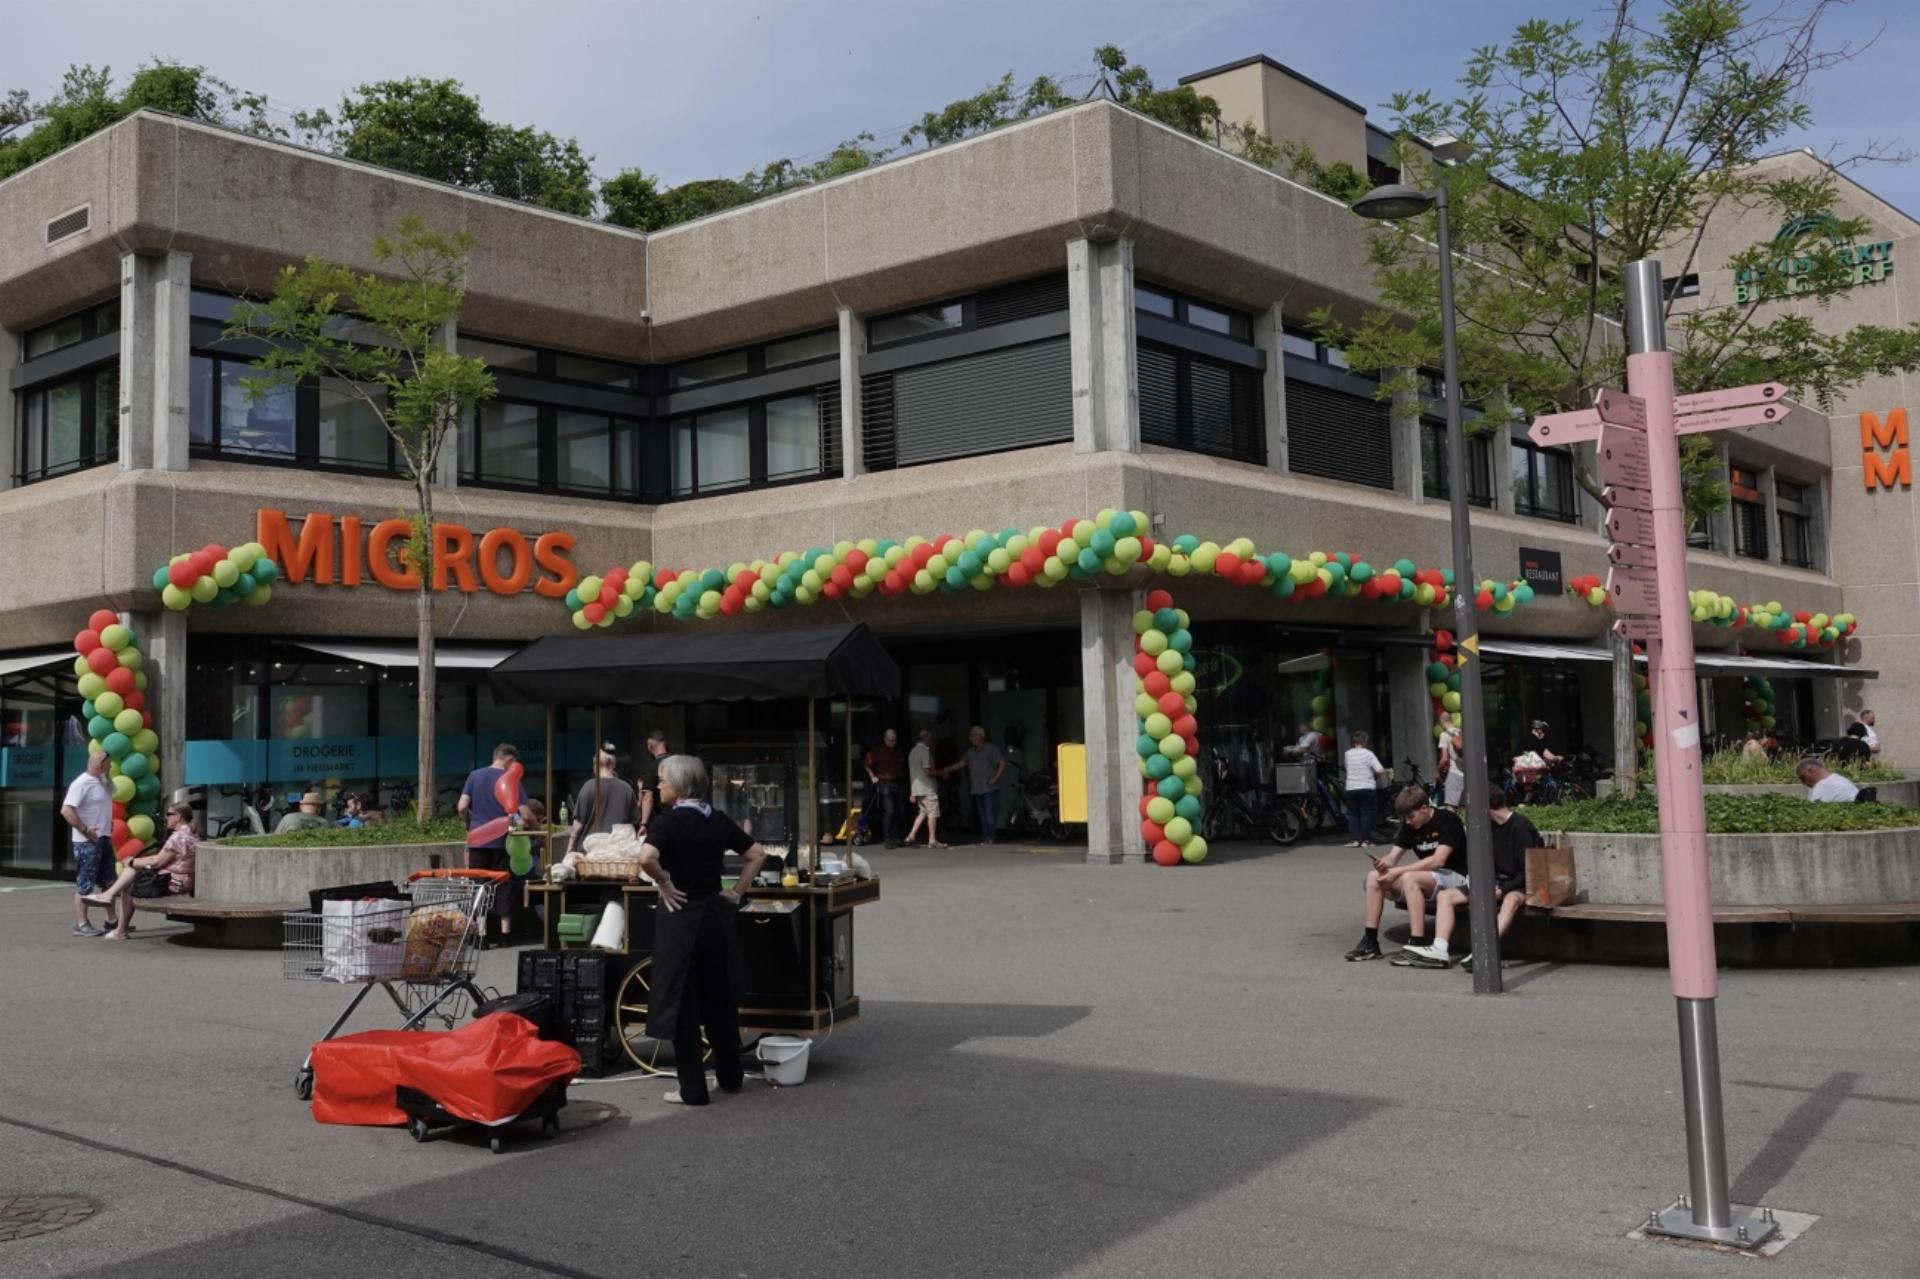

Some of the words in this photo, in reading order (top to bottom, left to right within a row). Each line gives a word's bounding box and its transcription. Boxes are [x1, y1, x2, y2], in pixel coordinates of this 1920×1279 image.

[257, 508, 577, 598] MIGROS
[293, 744, 356, 758] DROGERIE
[293, 764, 304, 773] IM
[307, 763, 355, 773] NEUMARKT
